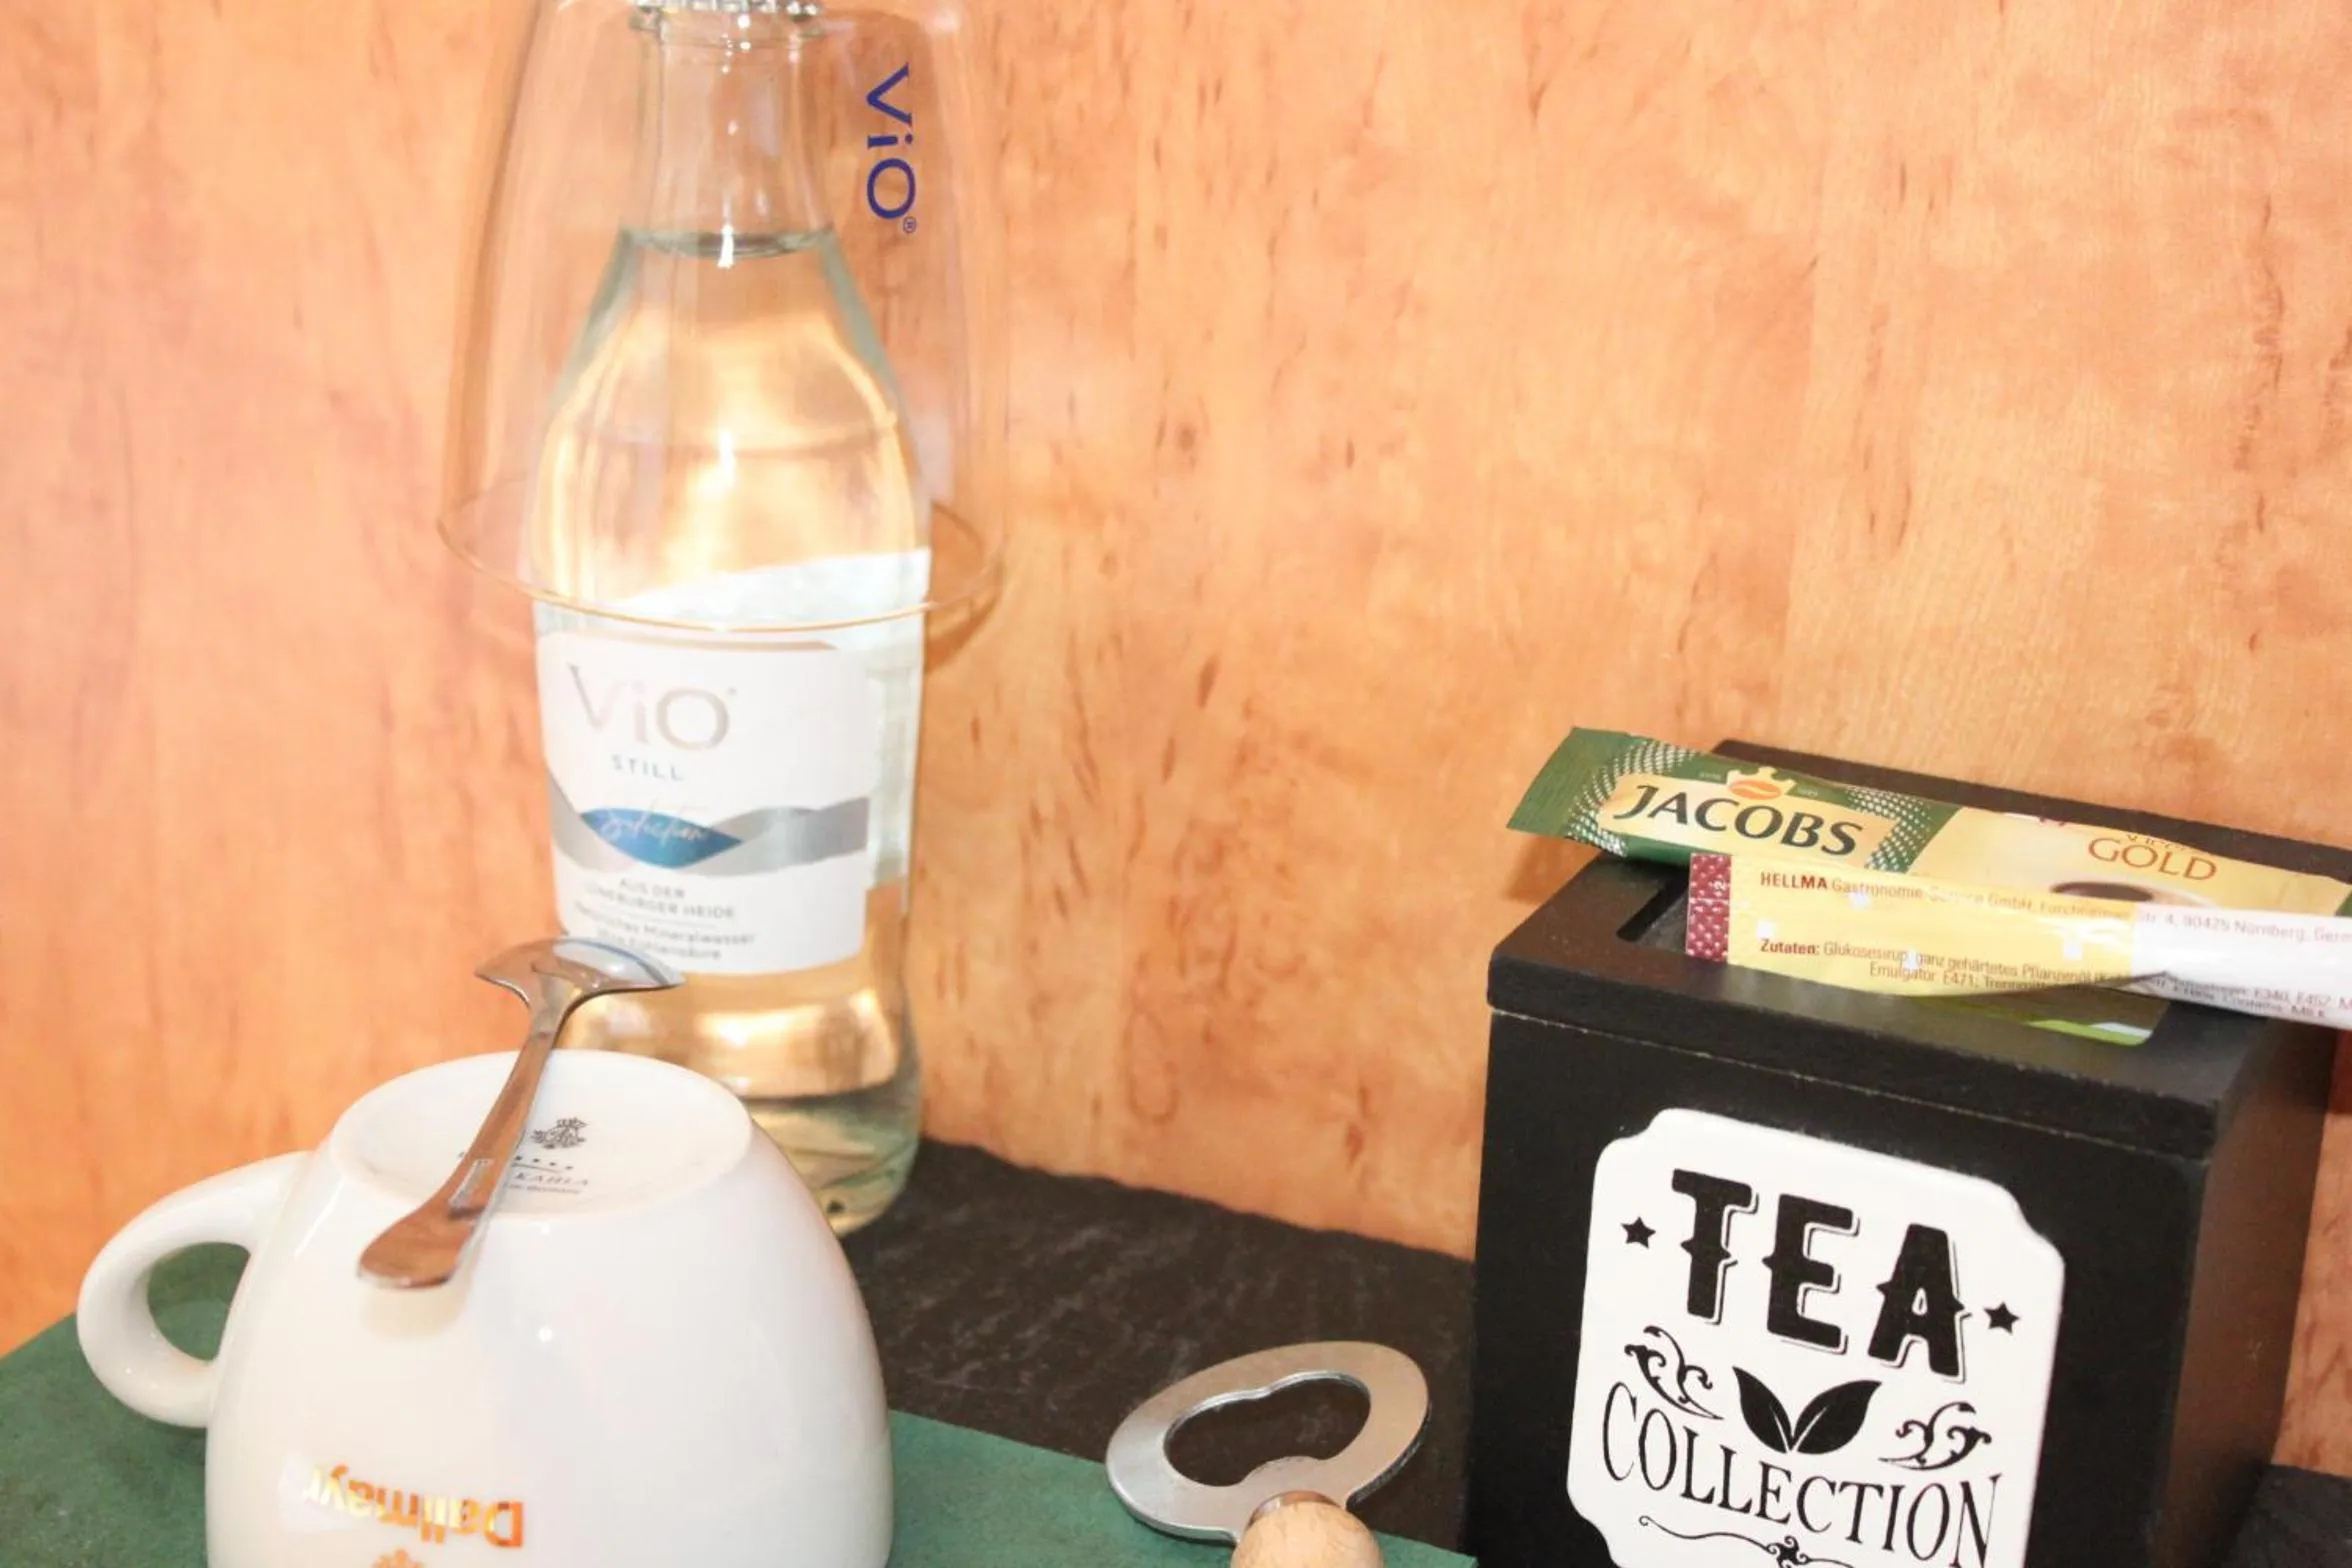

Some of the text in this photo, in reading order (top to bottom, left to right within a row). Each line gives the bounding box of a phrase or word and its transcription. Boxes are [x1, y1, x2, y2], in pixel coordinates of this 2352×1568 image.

[612, 754, 685, 782] STILL
[1613, 784, 1864, 858] JACOBS
[1760, 871, 1828, 889] HELLMA
[2088, 837, 2218, 881] GOLD
[1760, 937, 1821, 956] Zutaten:
[1671, 1168, 1972, 1384] TEA
[1602, 1381, 2003, 1568] COLLECTION
